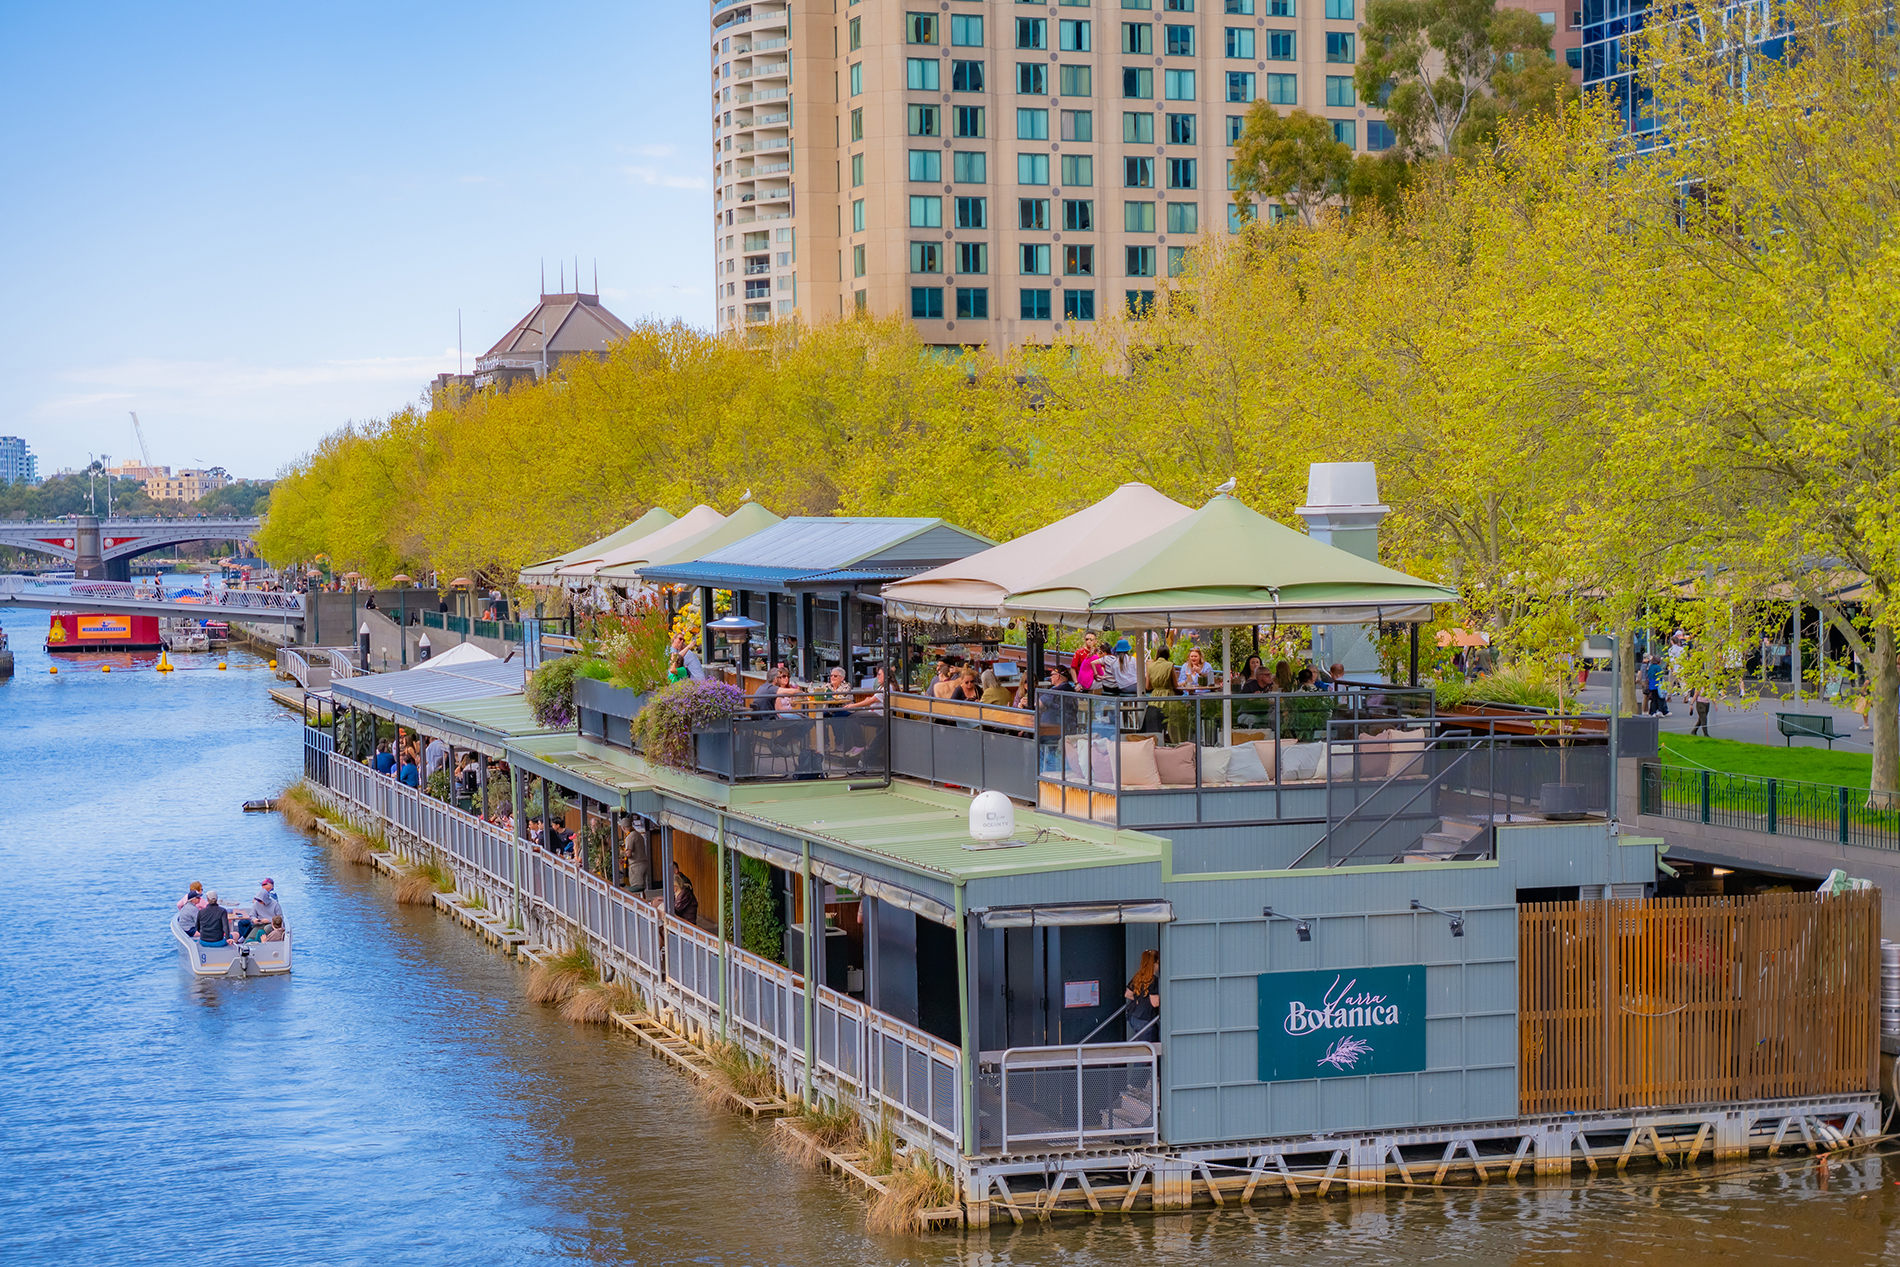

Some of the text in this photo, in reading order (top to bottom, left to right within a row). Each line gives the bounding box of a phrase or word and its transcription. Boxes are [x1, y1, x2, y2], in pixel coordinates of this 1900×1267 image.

[201, 953, 207, 964] 9
[1323, 974, 1387, 1011] Yarra
[1288, 1001, 1400, 1031] Botanica
